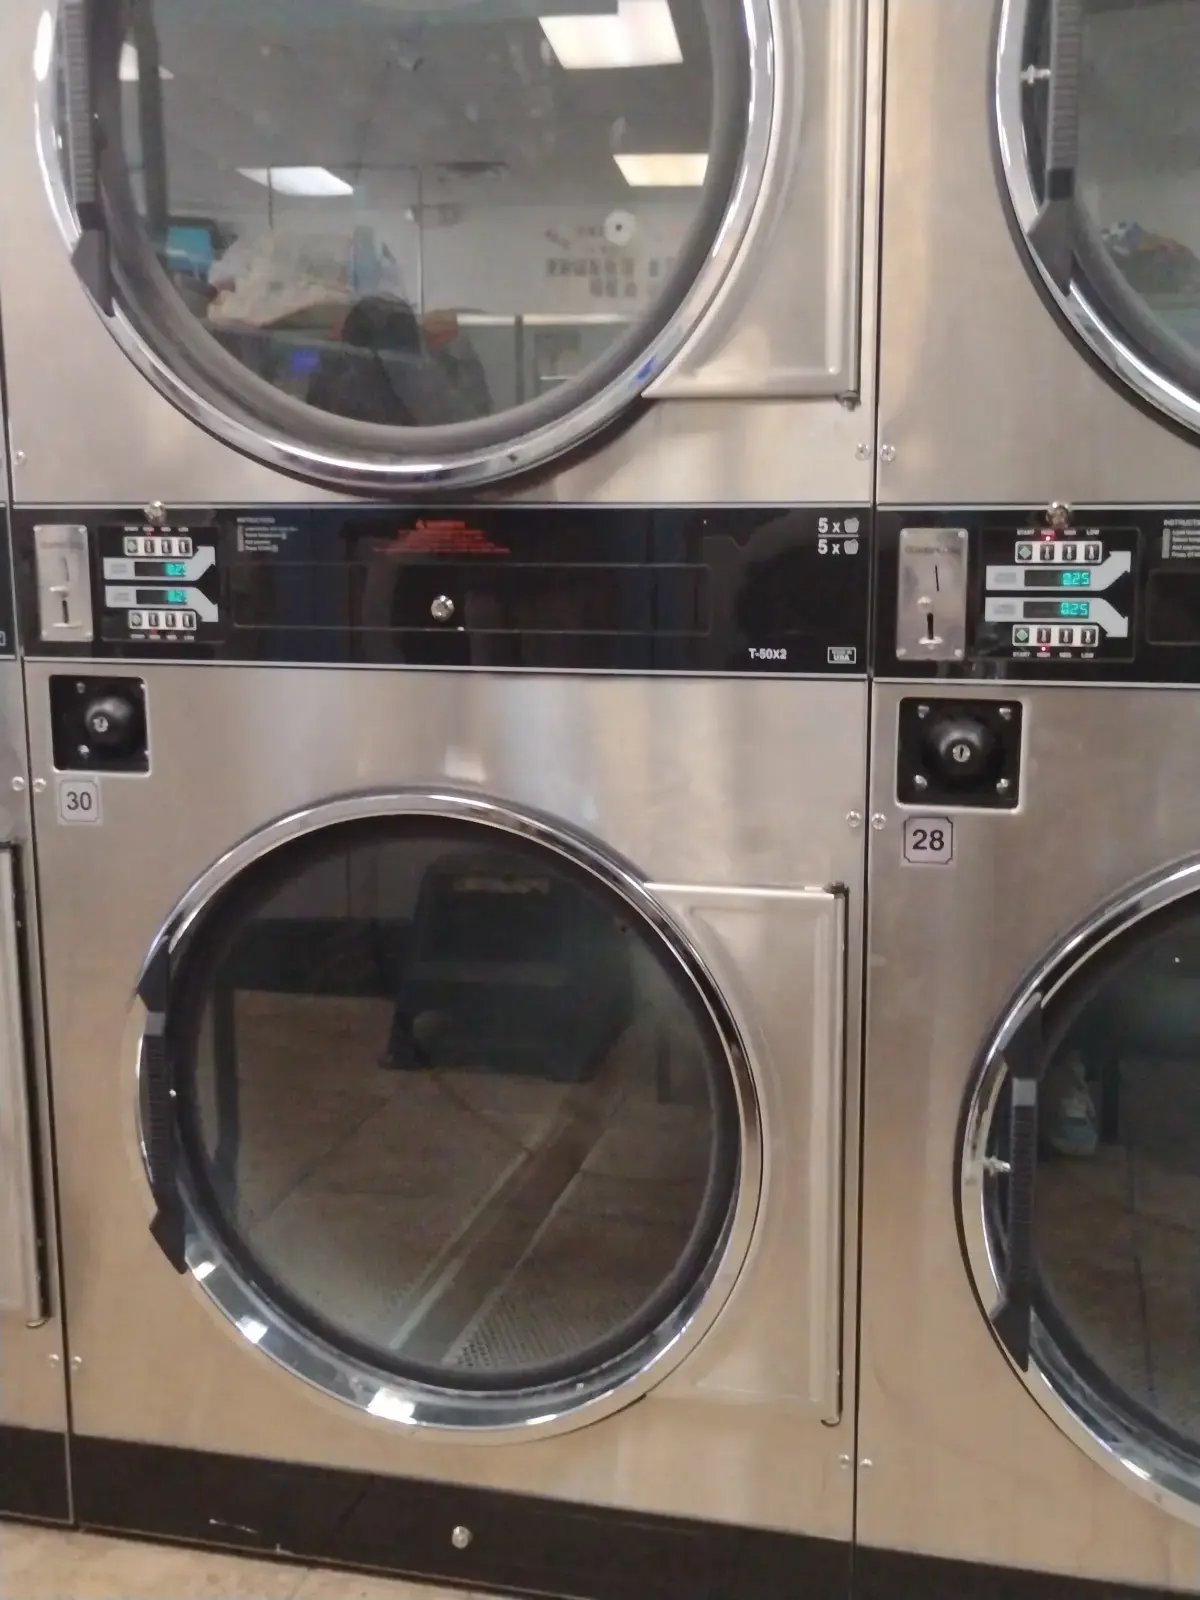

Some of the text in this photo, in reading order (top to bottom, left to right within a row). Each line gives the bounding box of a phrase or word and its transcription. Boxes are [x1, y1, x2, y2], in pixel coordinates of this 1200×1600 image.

[818, 517, 840, 533] 5 x
[818, 538, 840, 555] 5 x
[748, 647, 787, 660] T-50X2
[66, 791, 92, 811] 30
[912, 829, 945, 851] 28
